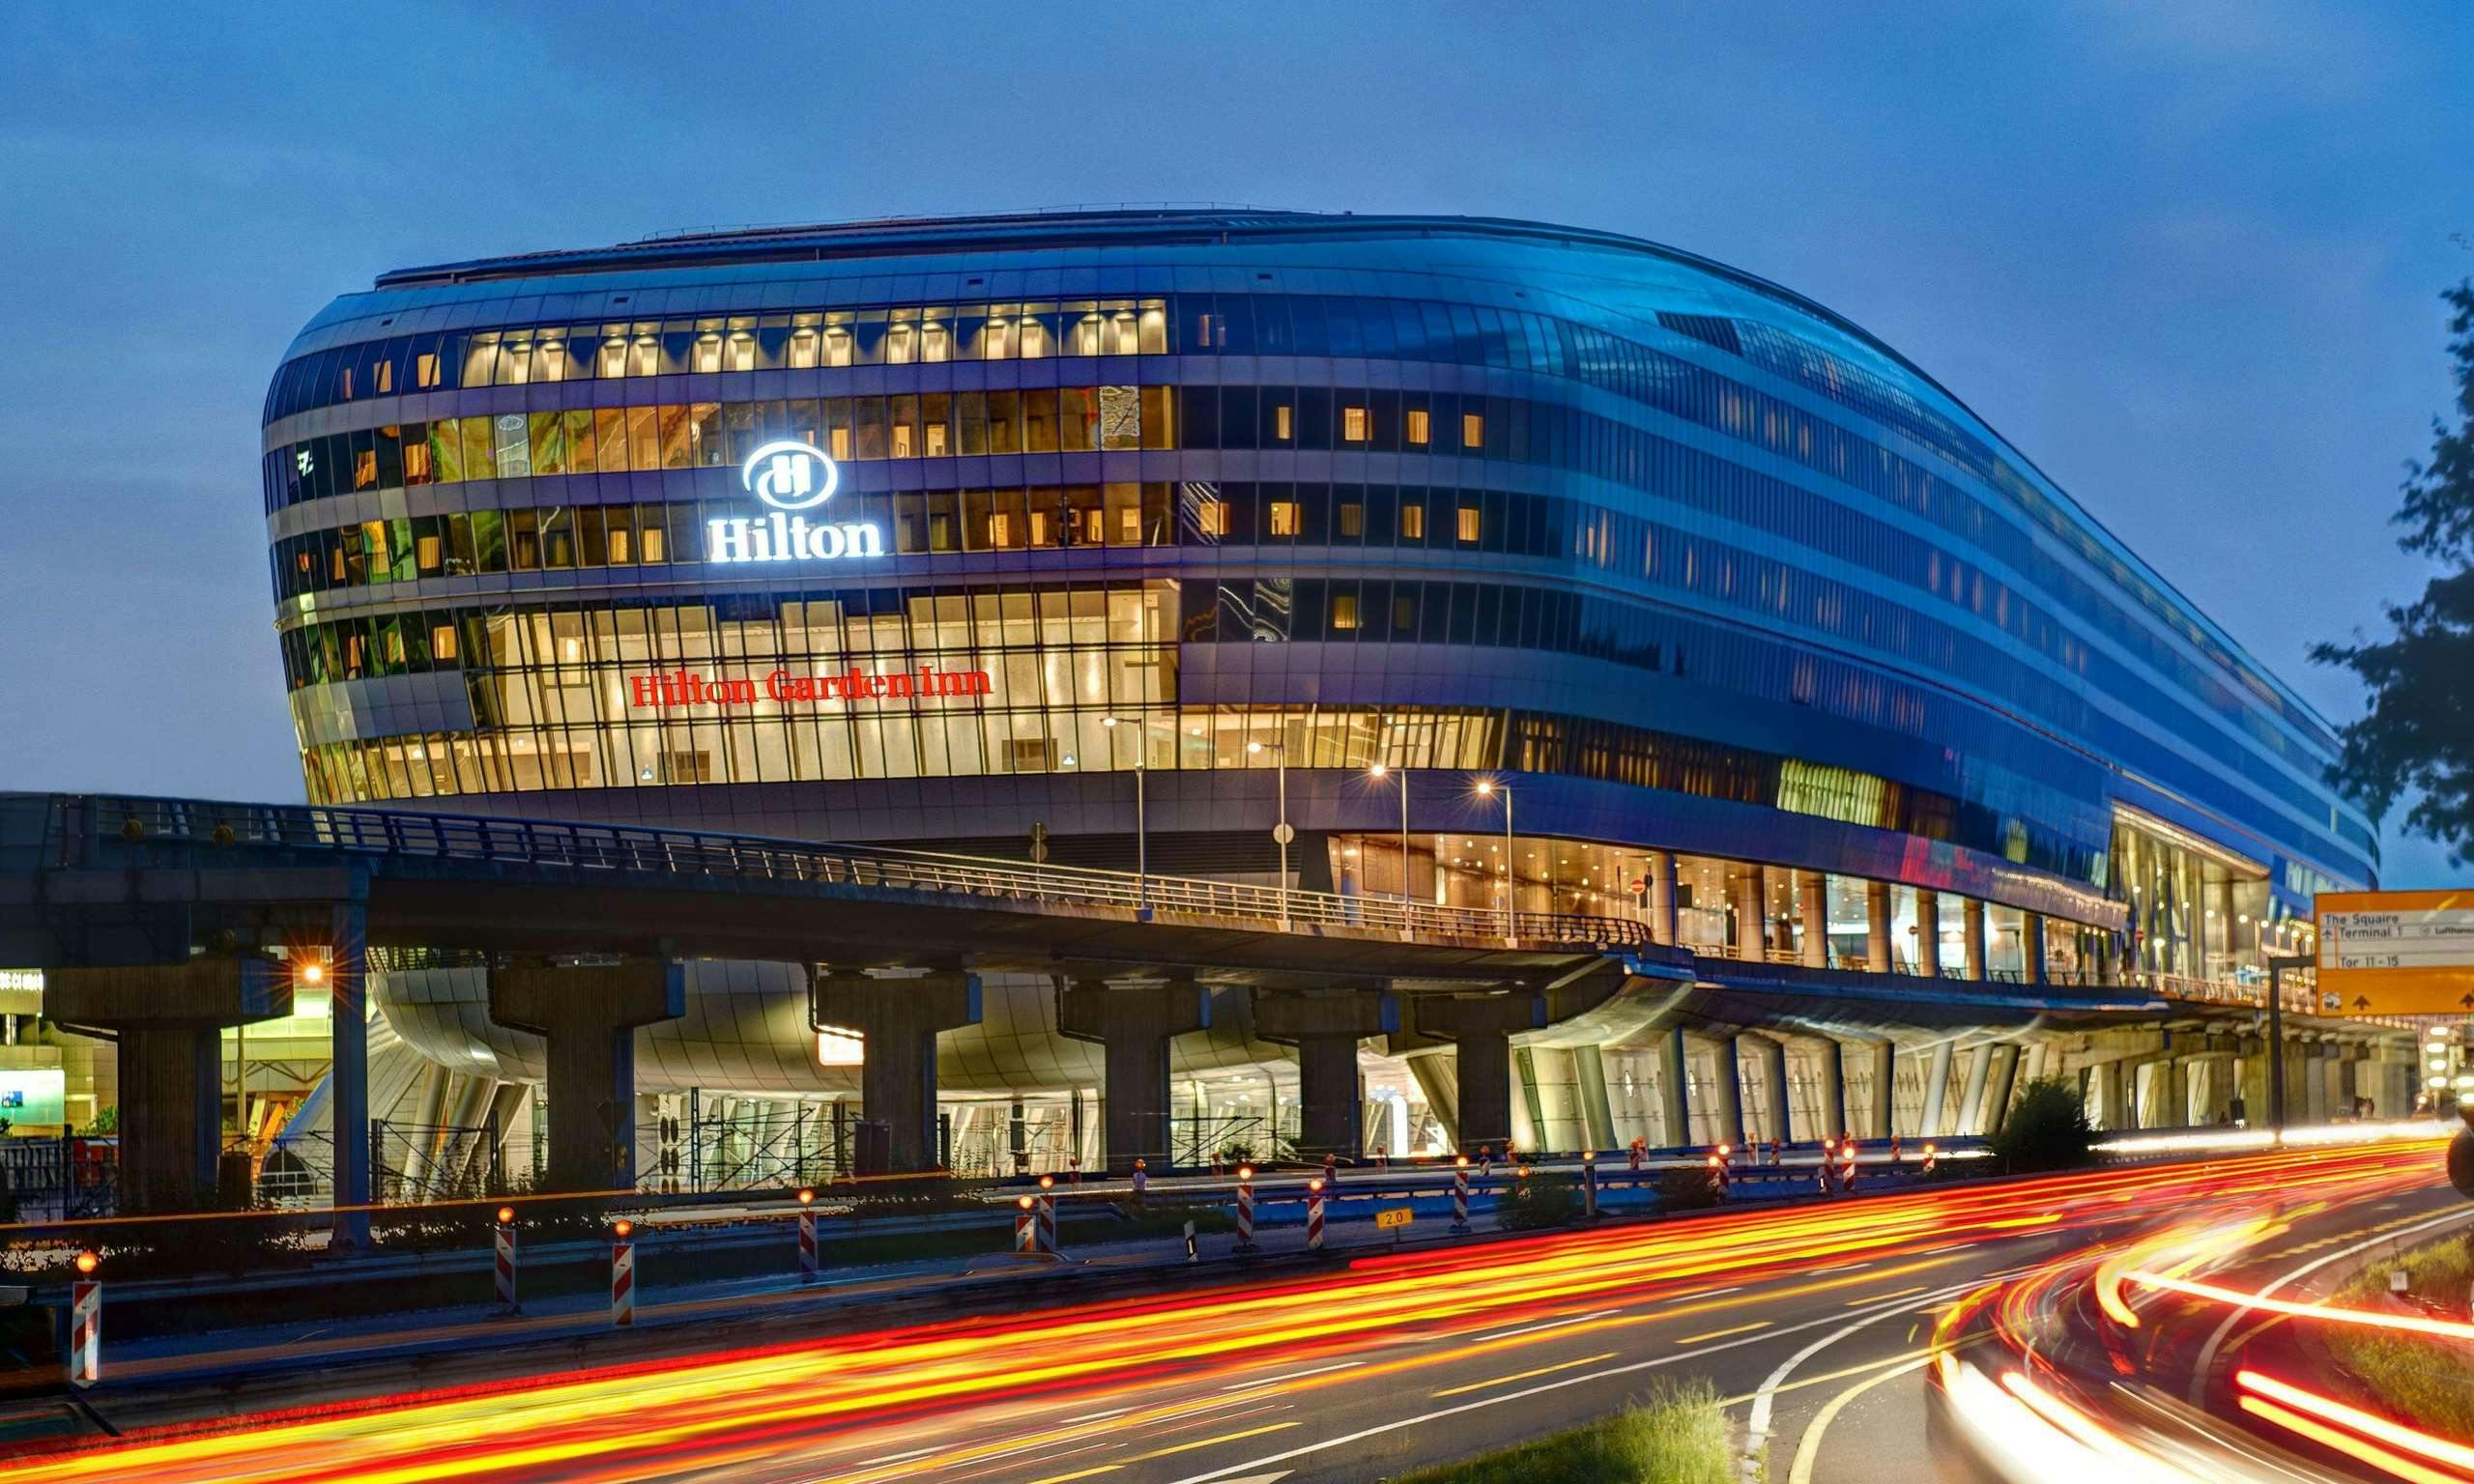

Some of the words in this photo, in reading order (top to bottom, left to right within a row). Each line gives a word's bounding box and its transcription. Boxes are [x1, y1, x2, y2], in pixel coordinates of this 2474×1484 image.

[708, 512, 885, 562] Hilton
[630, 671, 759, 706] Hilton
[767, 667, 914, 701] Garden
[919, 666, 993, 697] Inn
[2325, 914, 2346, 926] The
[2352, 913, 2399, 927] Squaire
[2340, 927, 2391, 939] Terminal
[2341, 956, 2358, 968] Tor
[2365, 956, 2374, 967] 11
[2387, 956, 2399, 967] 15
